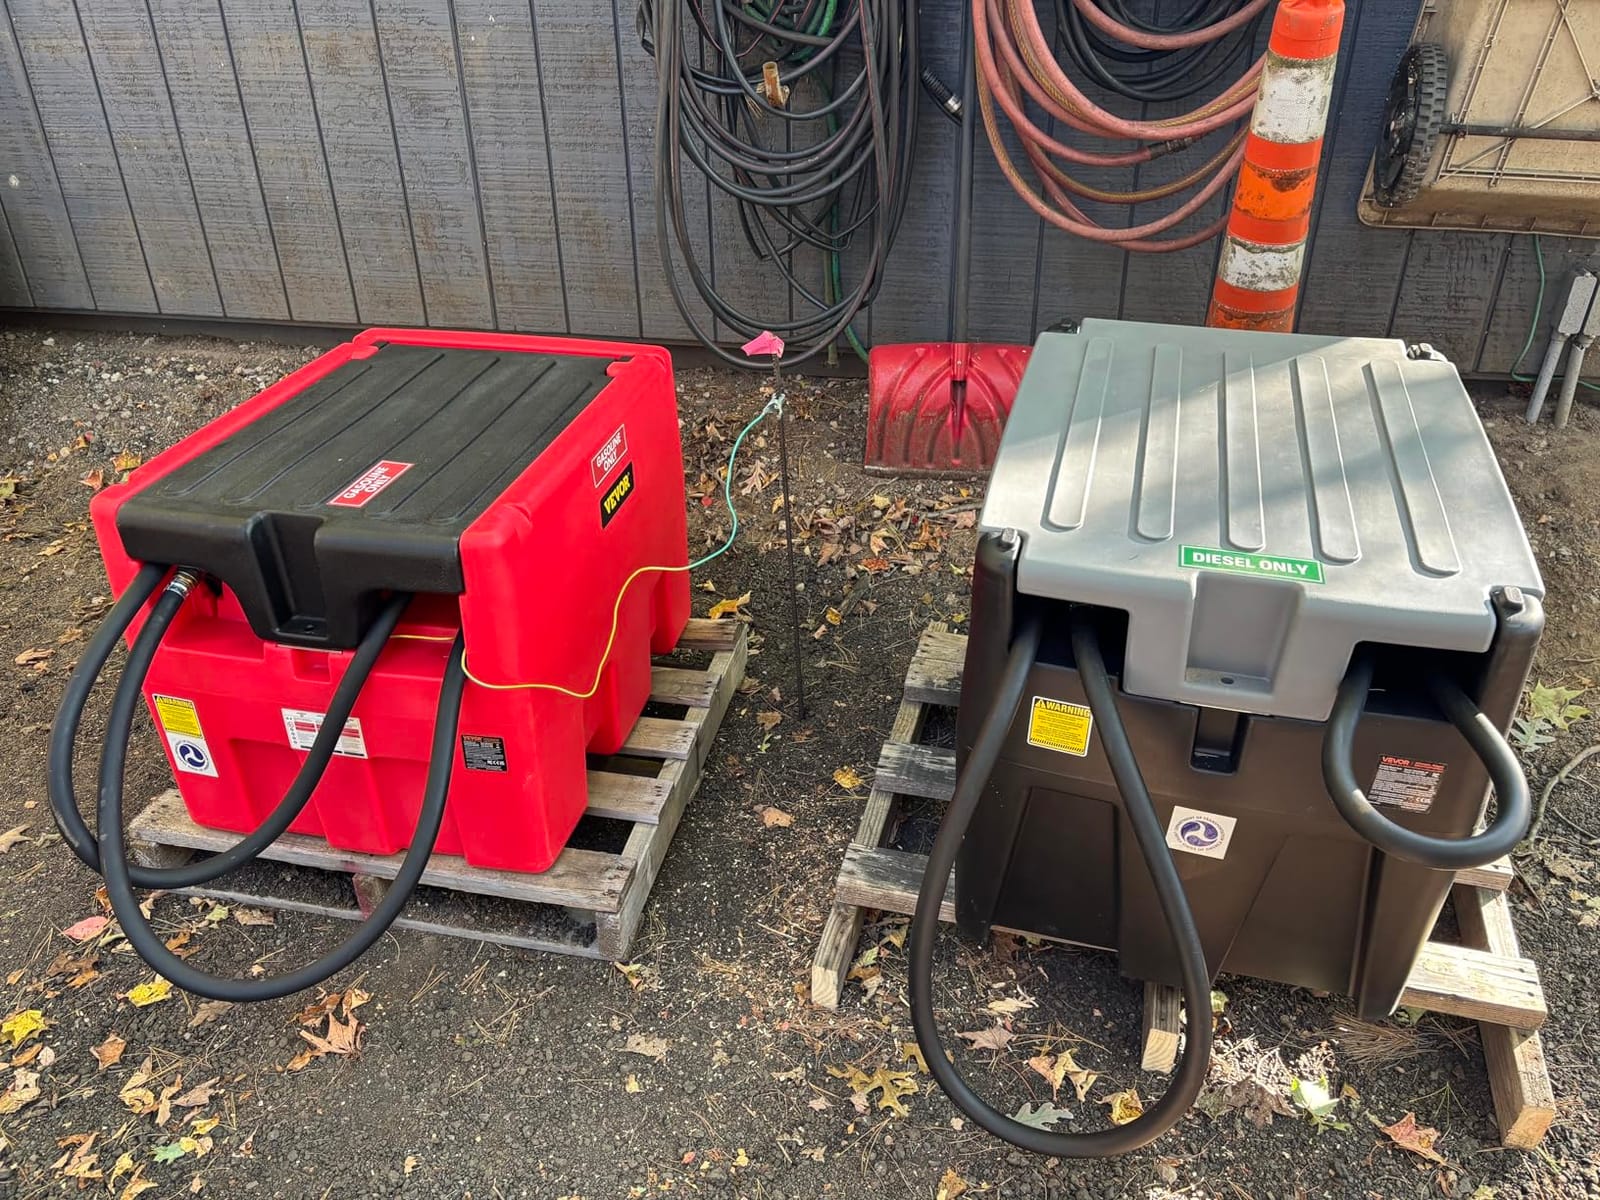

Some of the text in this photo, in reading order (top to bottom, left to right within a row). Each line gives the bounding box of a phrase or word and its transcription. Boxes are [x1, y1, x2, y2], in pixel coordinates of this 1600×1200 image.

[596, 432, 622, 468] GASOLINE
[603, 449, 618, 472] ONLY
[343, 466, 390, 499] GASOLINE
[364, 475, 392, 493] ONLY
[603, 474, 631, 515] VEVOR
[1192, 551, 1309, 576] DIESEL ONLY
[1046, 701, 1091, 718] WARNING
[1382, 756, 1410, 766] VEVOR
